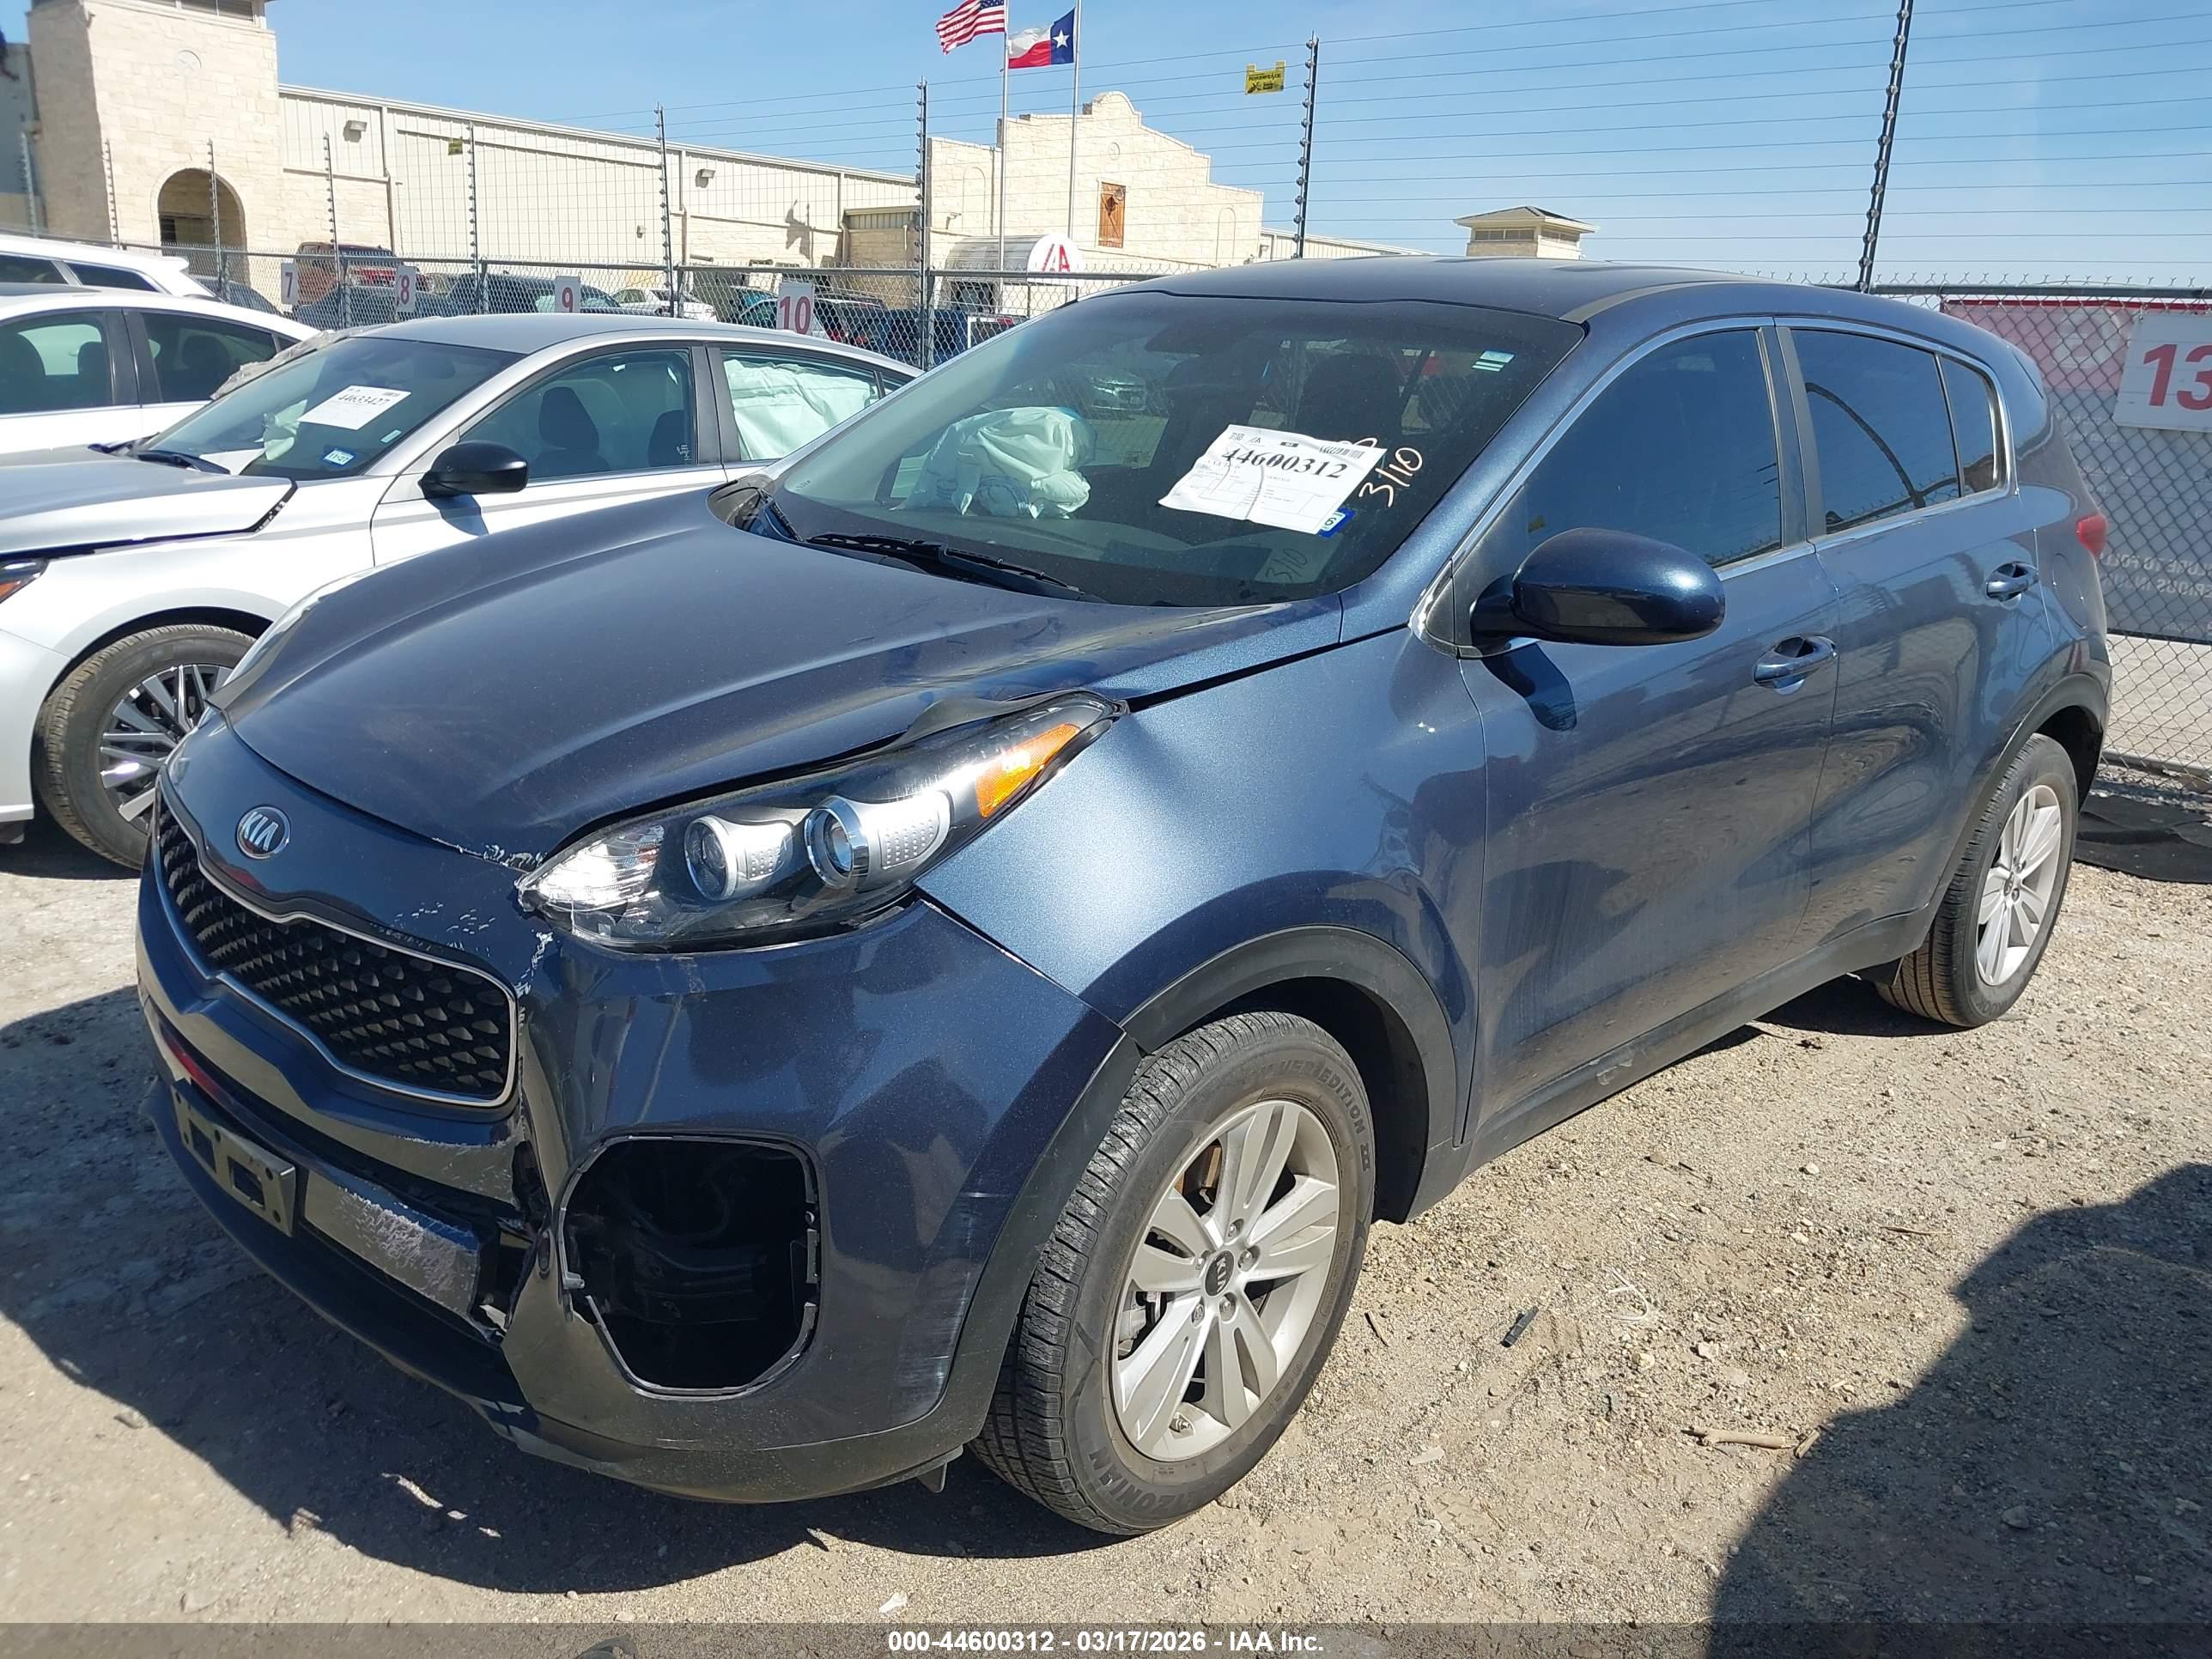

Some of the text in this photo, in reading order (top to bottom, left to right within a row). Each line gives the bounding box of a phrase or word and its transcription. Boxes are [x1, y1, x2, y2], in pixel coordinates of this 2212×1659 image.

[285, 271, 294, 299] 7
[400, 274, 410, 305] 8
[562, 287, 574, 313] 9
[779, 295, 811, 335] 10
[2143, 343, 2212, 411] 13
[1222, 447, 1348, 479] 44600312
[1358, 447, 1423, 508] 3/10
[240, 811, 279, 852] KIA
[1316, 1067, 1367, 1135] EDITION
